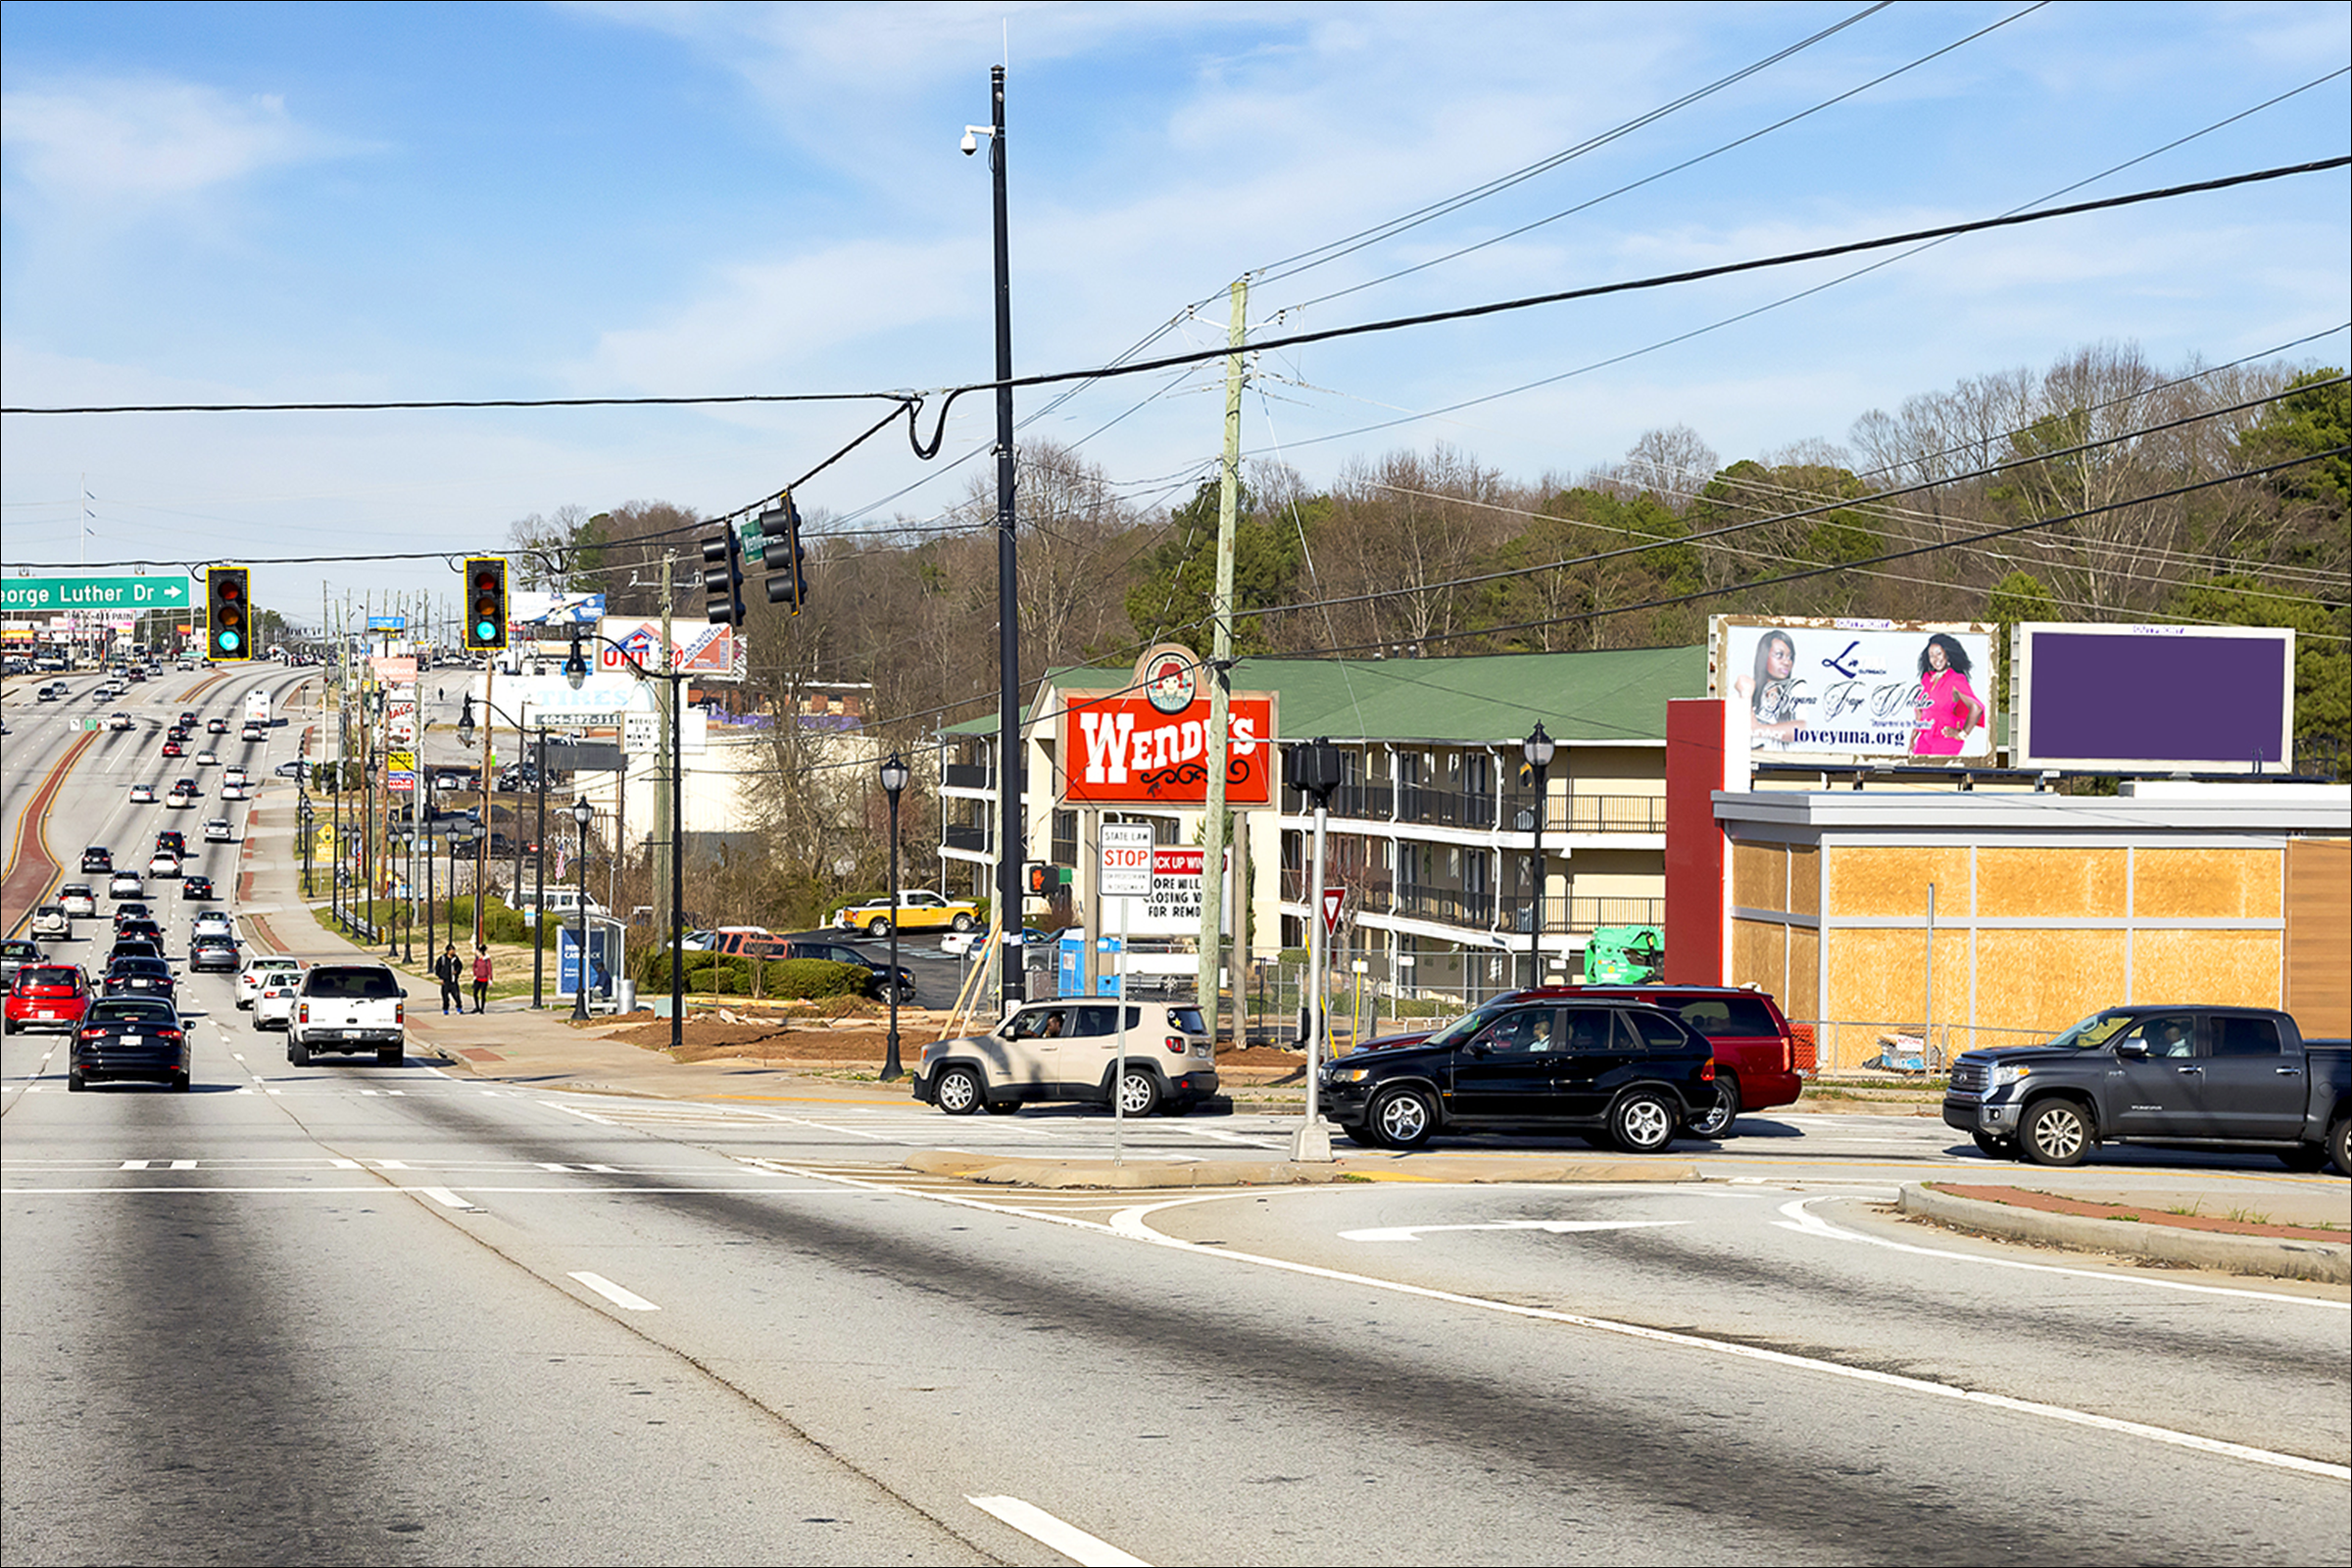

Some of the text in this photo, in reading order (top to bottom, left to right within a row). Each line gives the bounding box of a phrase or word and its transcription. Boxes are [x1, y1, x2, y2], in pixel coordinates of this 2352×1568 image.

[60, 585, 123, 603] Luther
[133, 584, 155, 601] Dr
[539, 690, 628, 707] TIRES
[1794, 728, 1904, 747] loveyuna.org
[1080, 712, 1256, 784] WEND'S
[1104, 831, 1149, 842] STATE LAW
[1104, 849, 1148, 866] STOP
[1172, 856, 1185, 869] UP
[1153, 878, 1201, 889] ORE WILL
[1149, 906, 1201, 917] FOR REMO
